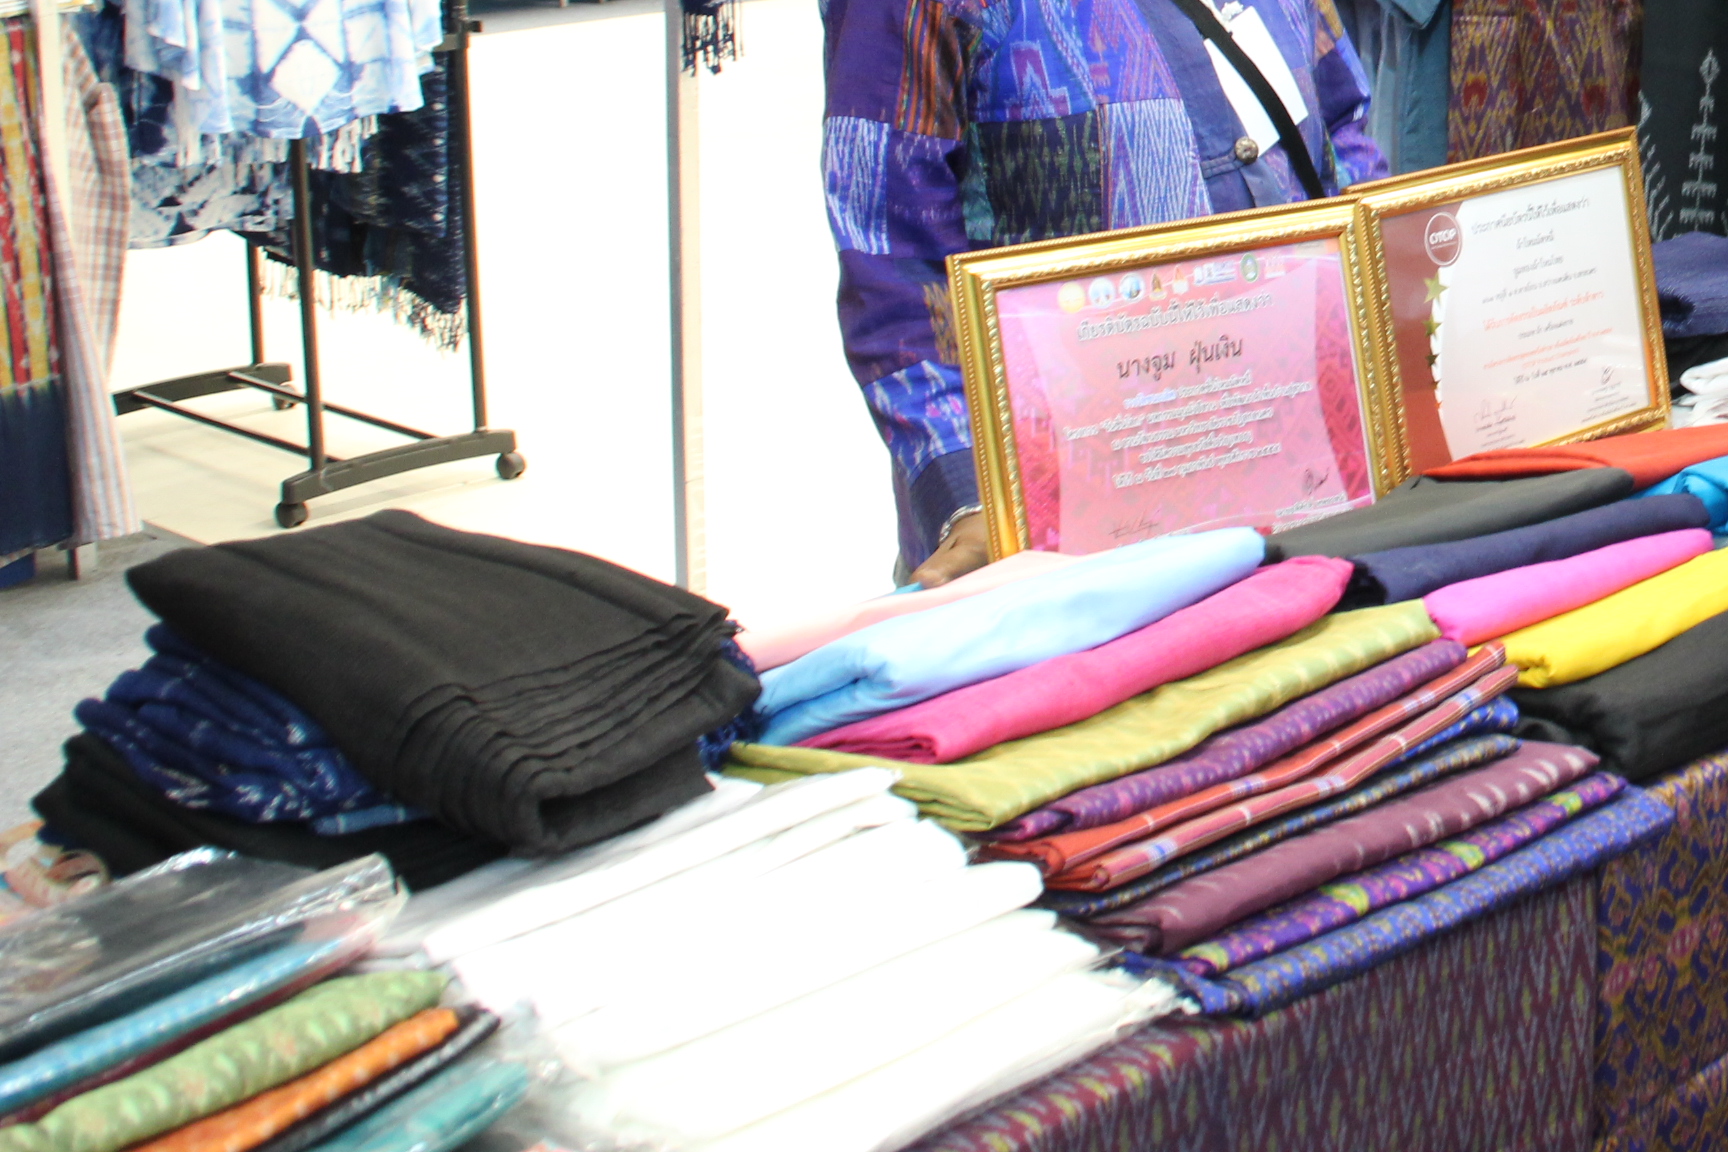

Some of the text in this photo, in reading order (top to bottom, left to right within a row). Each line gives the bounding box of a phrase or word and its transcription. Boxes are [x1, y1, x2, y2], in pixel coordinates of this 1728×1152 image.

[1429, 227, 1457, 245] OTOP
[1117, 351, 1176, 381] นางจูม
